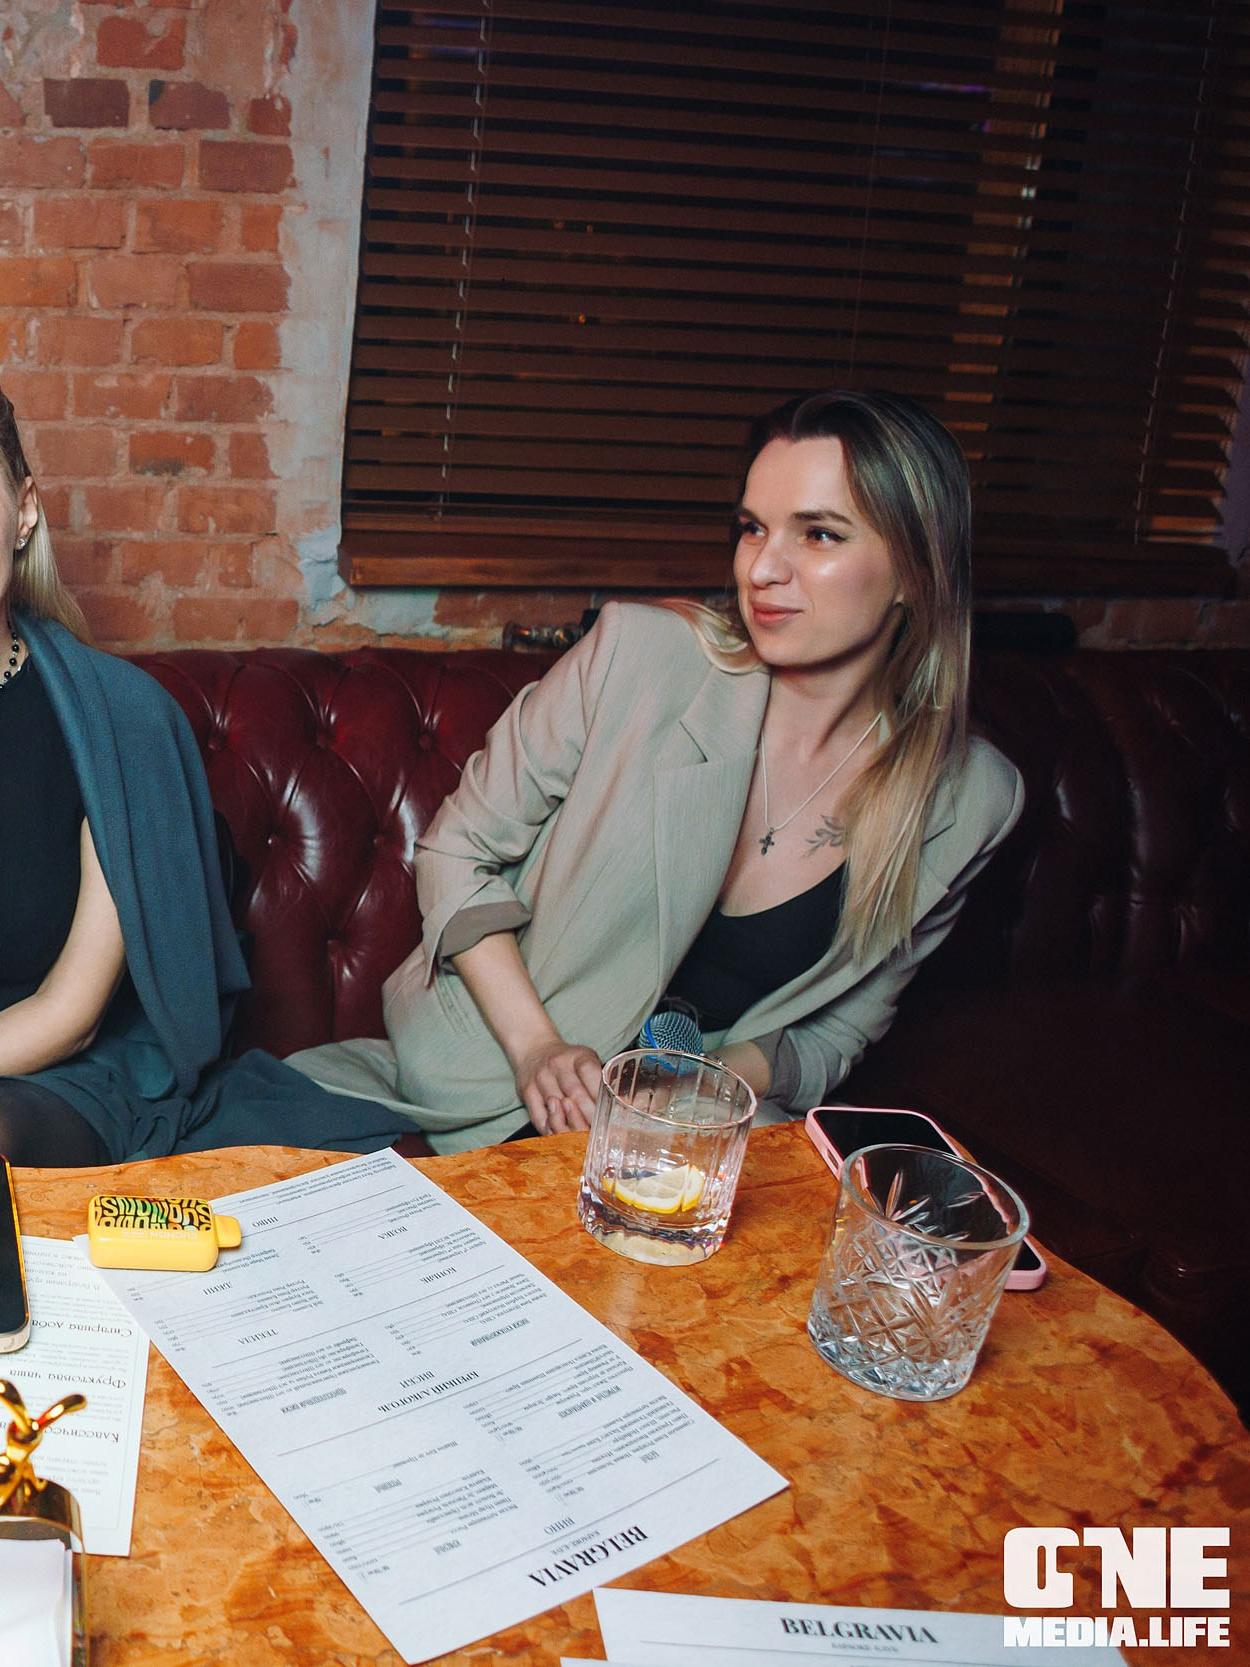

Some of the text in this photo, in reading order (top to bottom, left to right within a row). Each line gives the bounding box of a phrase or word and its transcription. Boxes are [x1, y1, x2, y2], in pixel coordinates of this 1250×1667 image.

[251, 1216, 279, 1227] ПИВО
[377, 1226, 407, 1240] ВОДКА
[419, 1266, 456, 1283] КОНЬЯК
[201, 1282, 233, 1294] ДЖИН
[69, 1322, 131, 1336] Сигарная
[237, 1328, 278, 1344] ТЕКИЛА
[9, 1368, 125, 1388] Фруктовая чаша
[398, 1371, 435, 1387] ВИСКИ
[376, 1370, 479, 1414] КРЕПКИЙ АЛКОГОЛЬ
[593, 1385, 621, 1400] ИГРИСТЫЕ
[542, 1517, 574, 1534] ВИНО
[527, 1526, 648, 1587] BELGRAVIA
[780, 1617, 937, 1645] BELGRAVIA
